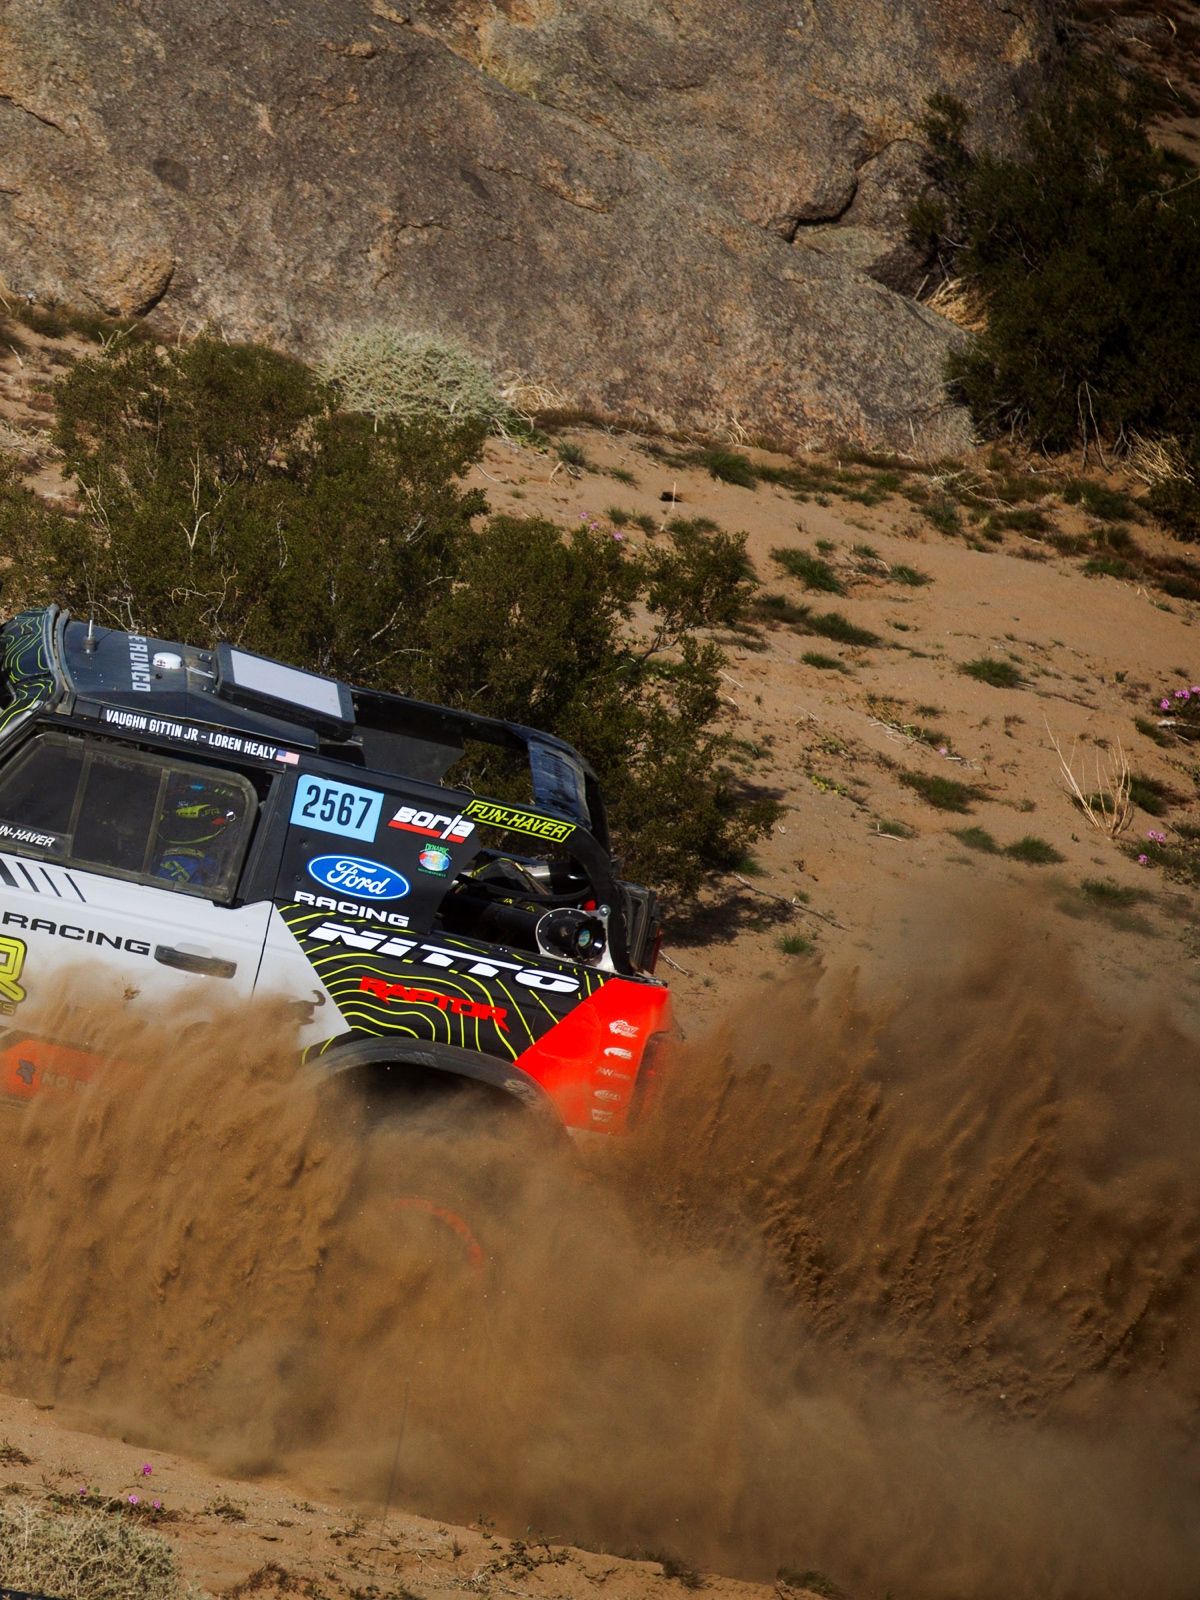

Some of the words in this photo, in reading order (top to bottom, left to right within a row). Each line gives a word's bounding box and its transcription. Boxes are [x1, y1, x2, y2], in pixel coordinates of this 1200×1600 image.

[106, 709, 147, 729] VAUGHN
[149, 719, 183, 738] GITTIN
[184, 727, 199, 741] JR
[208, 732, 241, 751] LOREN
[243, 741, 277, 760] HEALY
[302, 784, 374, 829] 2567
[468, 803, 568, 839] FUN-HAVER
[326, 860, 391, 895] Ford
[293, 890, 410, 928] RACING
[2, 911, 152, 957] RACING
[307, 921, 581, 994] NITTO
[359, 975, 511, 1034] RAPTOR
